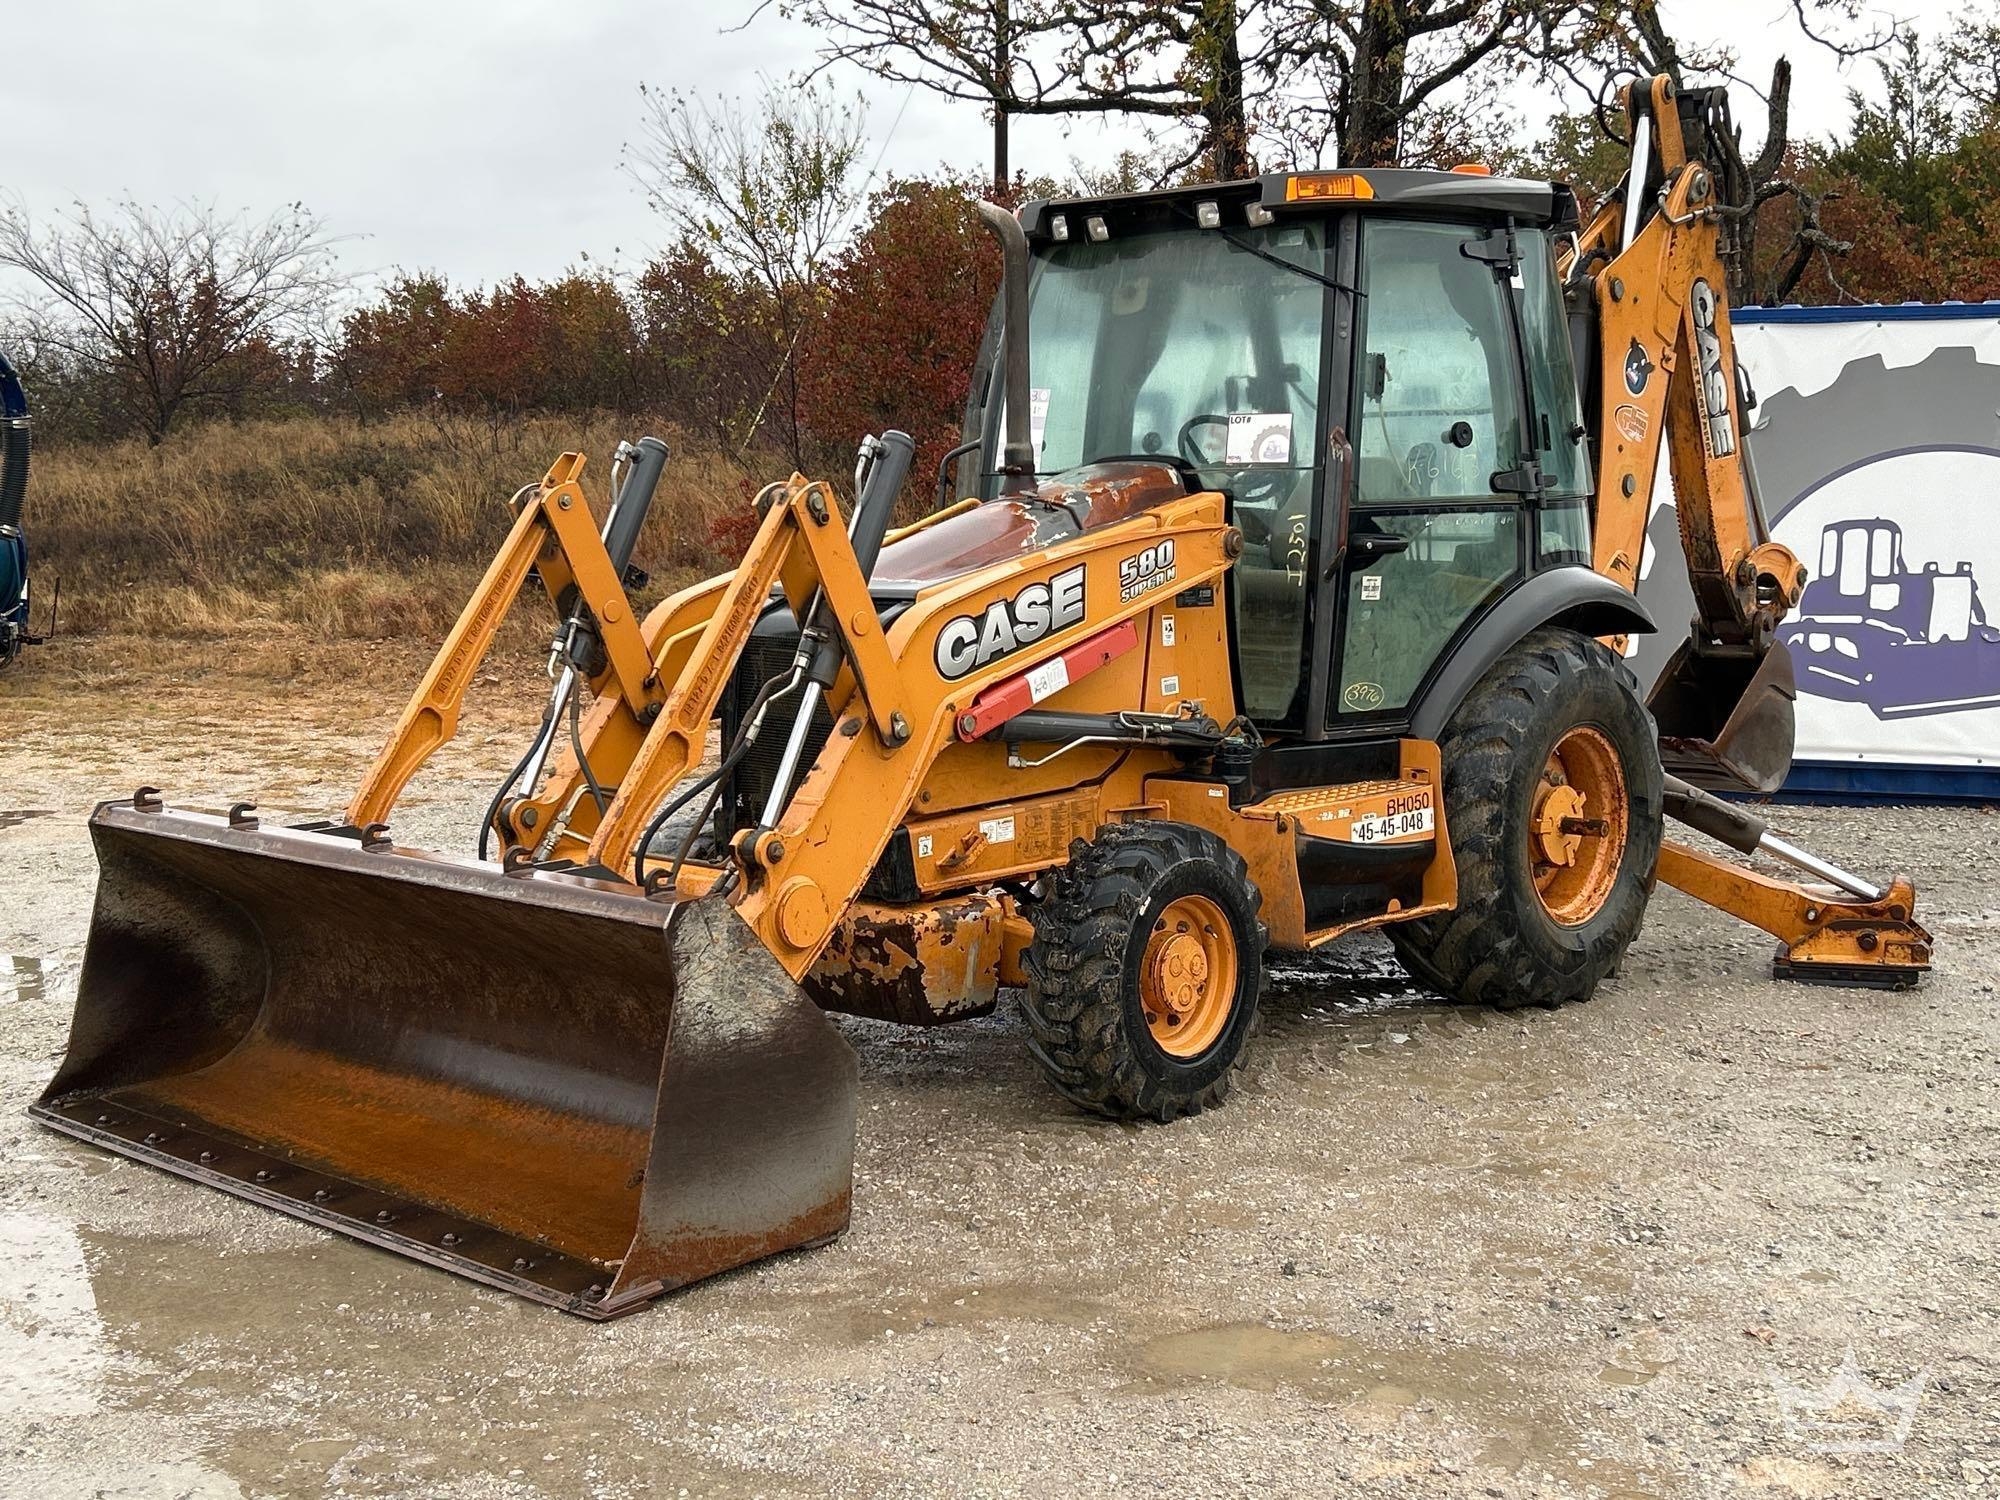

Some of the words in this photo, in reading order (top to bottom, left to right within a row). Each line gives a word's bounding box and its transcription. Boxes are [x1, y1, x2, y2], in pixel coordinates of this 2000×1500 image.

[1692, 280, 1736, 457] CASE
[1230, 416, 1252, 424] LOT#
[1119, 538, 1175, 588] 580
[1120, 571, 1165, 604] SUPER
[1165, 565, 1177, 583] N
[936, 564, 1086, 679] CASE
[1387, 791, 1430, 817] BH050
[1358, 812, 1424, 842] 45-45-048
